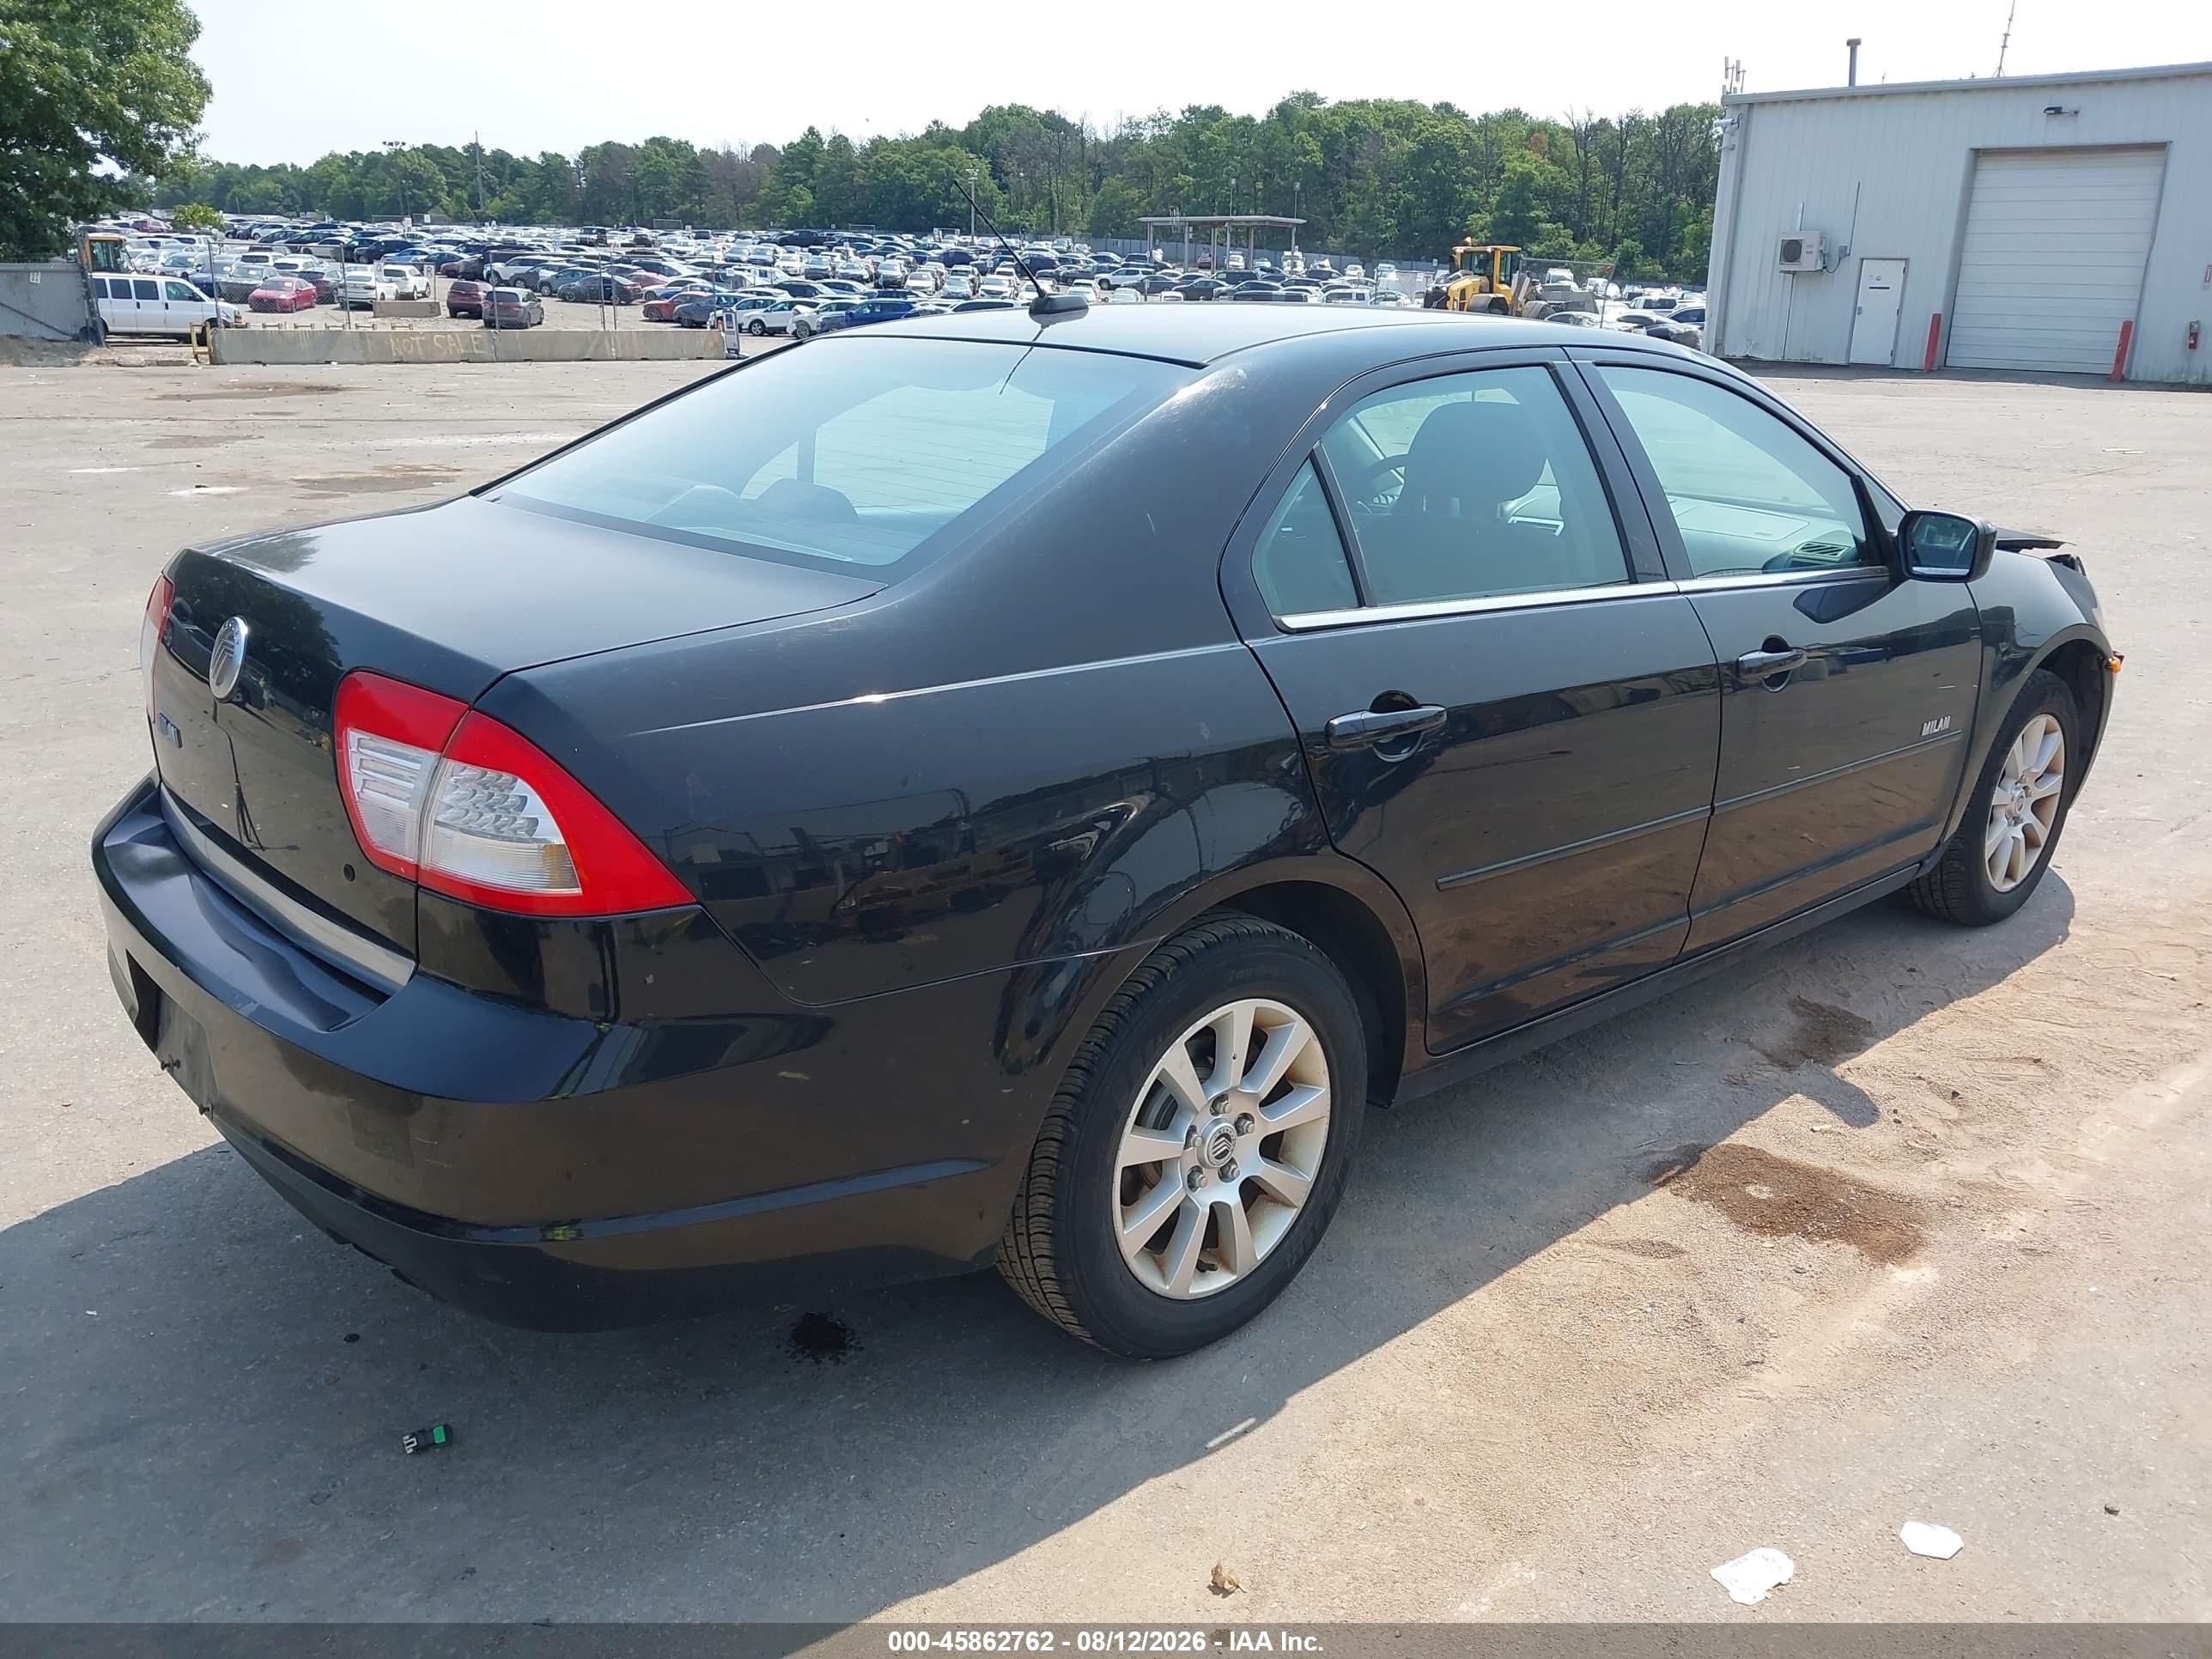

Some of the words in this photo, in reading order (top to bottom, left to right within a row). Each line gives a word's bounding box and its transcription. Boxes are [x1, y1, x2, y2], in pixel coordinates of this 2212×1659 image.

[426, 266, 433, 276] R
[390, 335, 426, 356] NOT
[433, 333, 488, 356] SALE
[1921, 714, 1951, 737] MILAN
